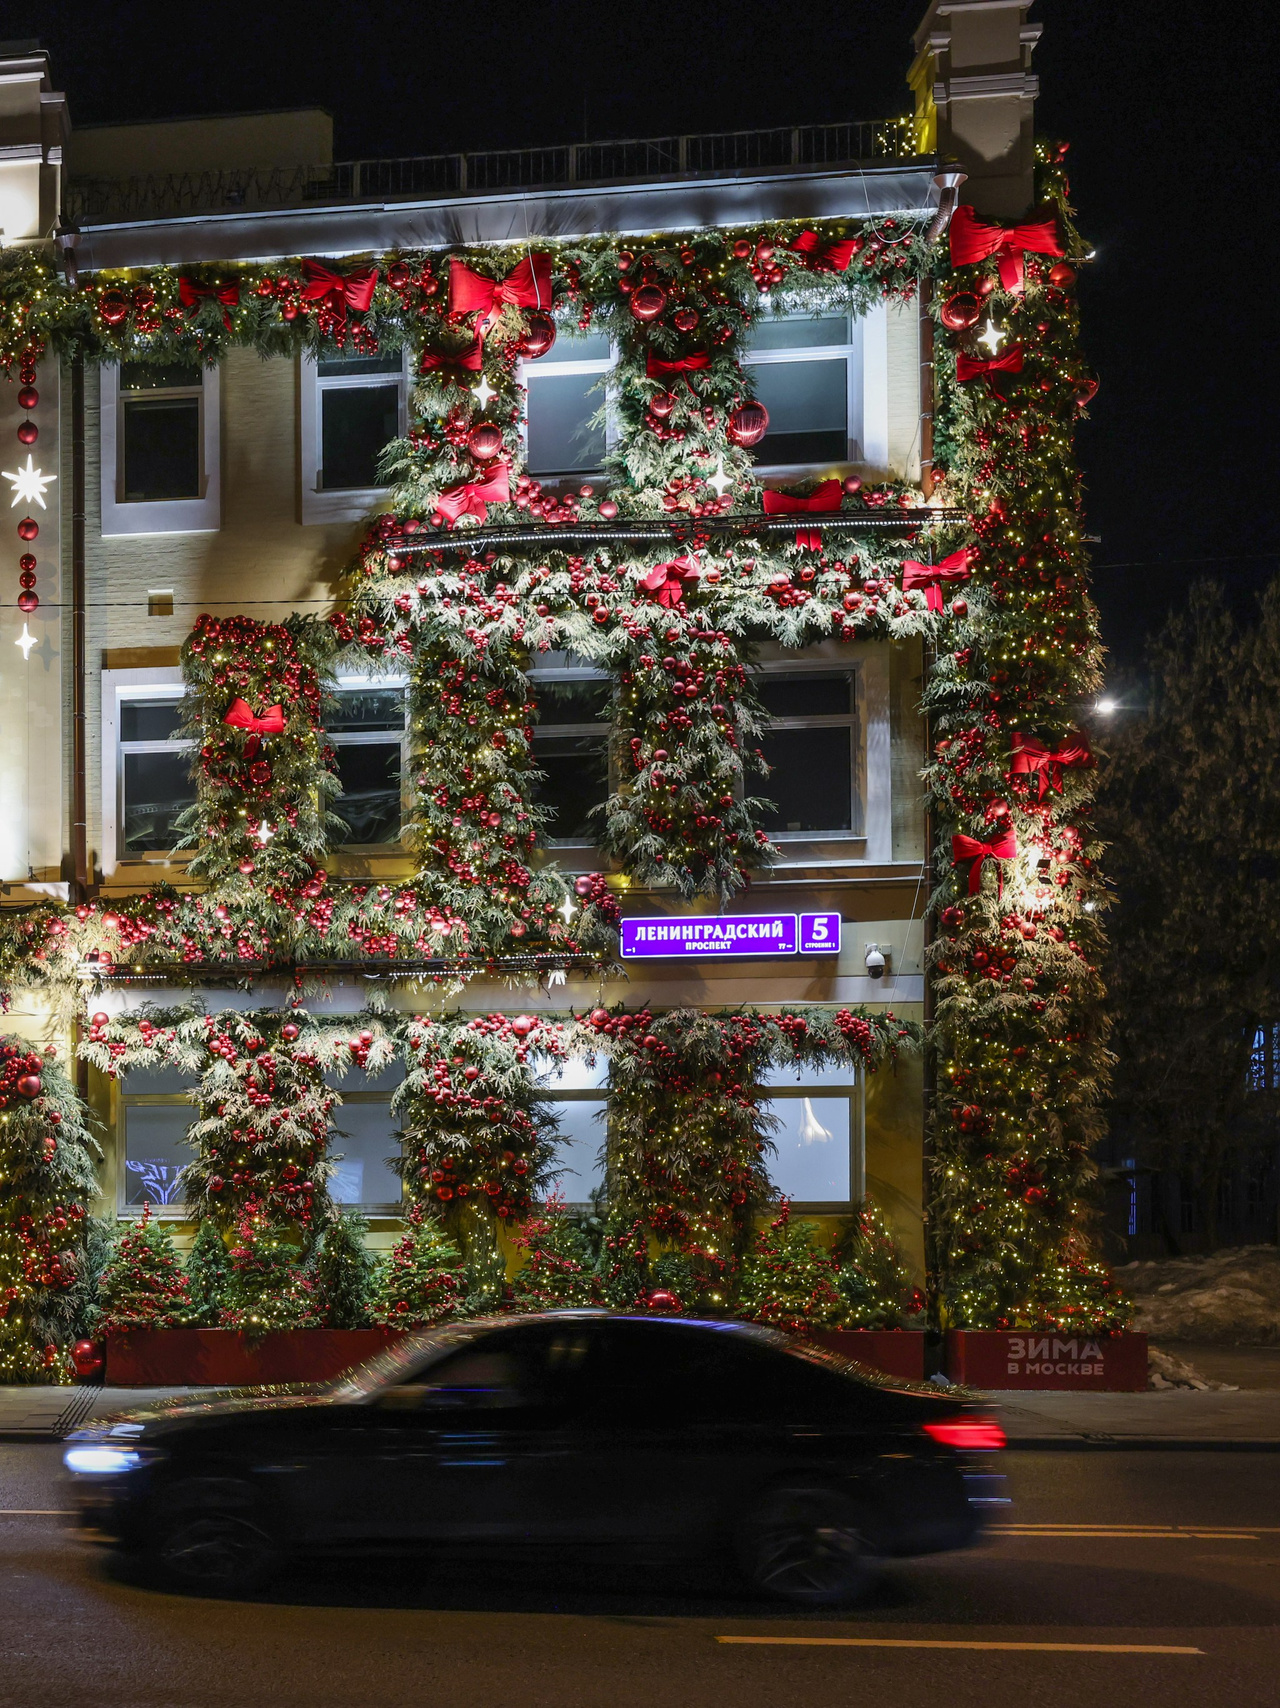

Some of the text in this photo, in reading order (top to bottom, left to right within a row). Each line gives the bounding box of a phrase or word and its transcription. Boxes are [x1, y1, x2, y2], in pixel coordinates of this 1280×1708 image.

[635, 920, 783, 941] ЛЕНИНГРАДСКИЙ
[812, 917, 828, 941] 5
[685, 941, 732, 950] ПРОСПЕКТ
[1007, 1338, 1104, 1359] ЗИМА
[1007, 1362, 1104, 1375] В МОСКВЕ
